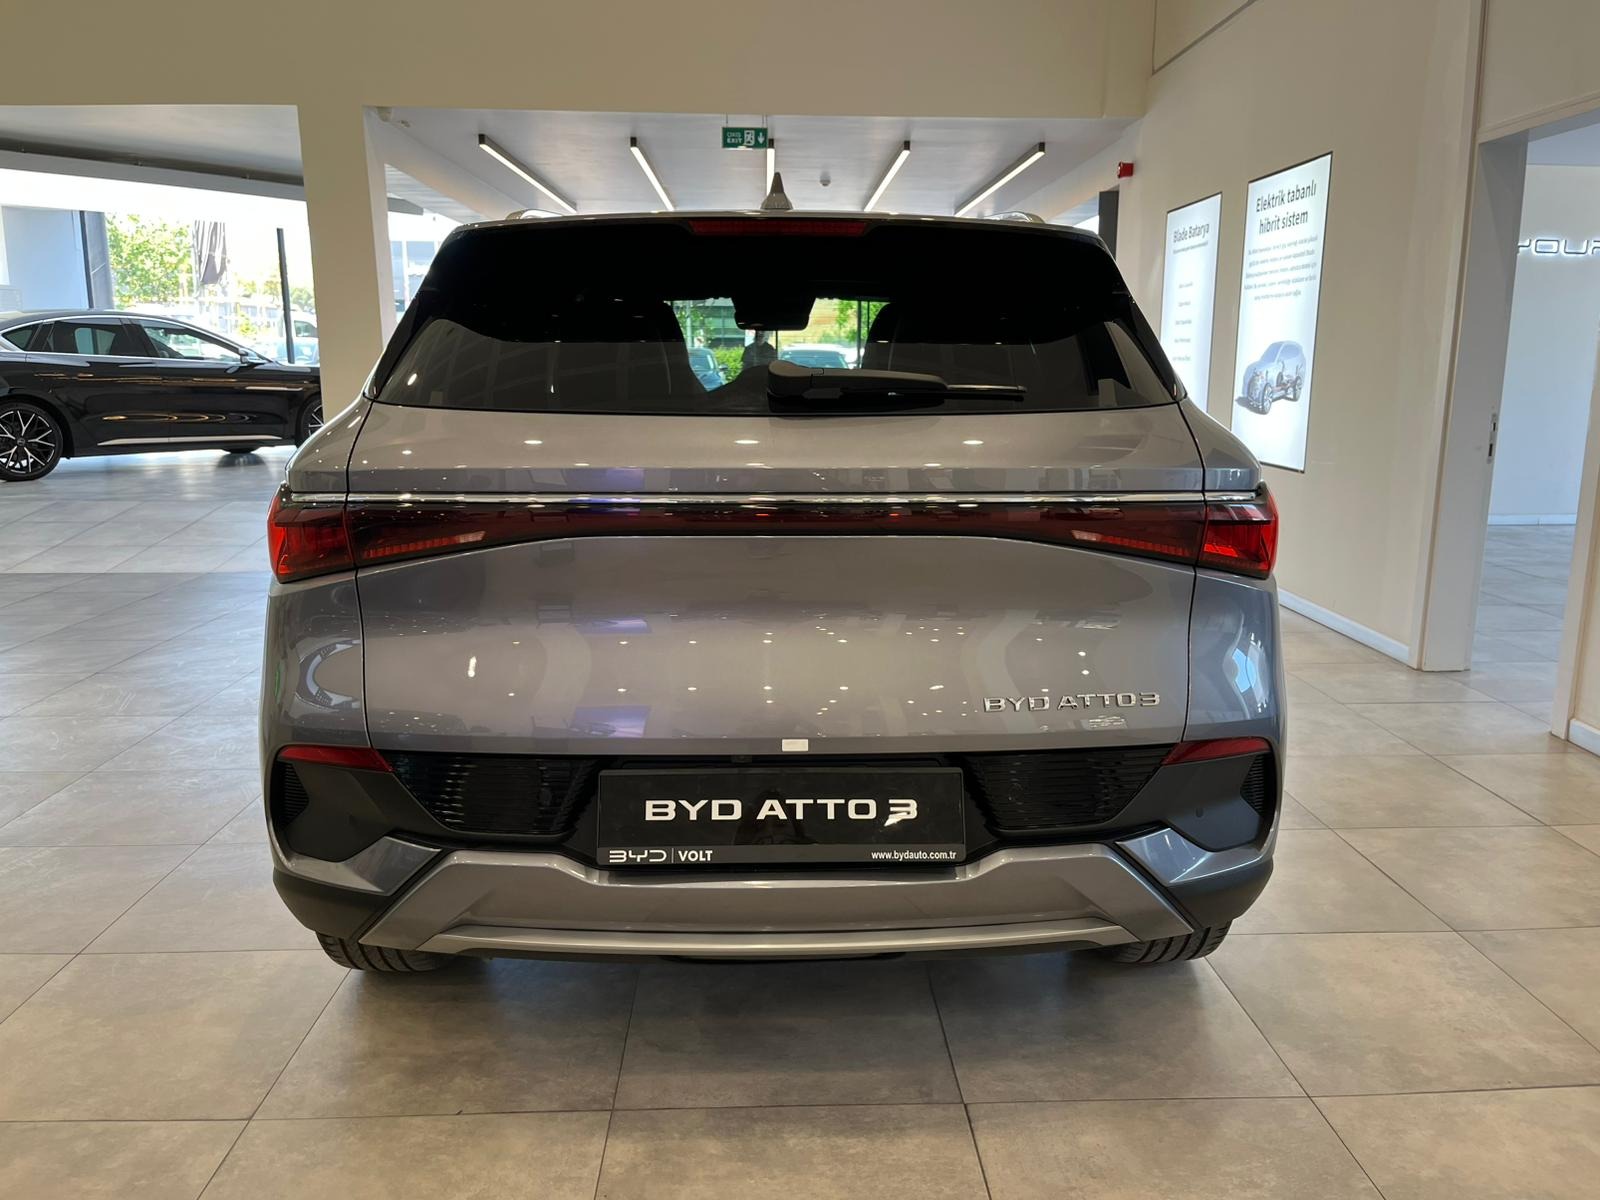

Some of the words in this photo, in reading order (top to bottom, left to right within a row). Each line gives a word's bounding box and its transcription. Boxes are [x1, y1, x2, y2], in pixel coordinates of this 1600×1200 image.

[1256, 188, 1285, 212] Elektrik
[1287, 180, 1317, 204] tabanlı
[1173, 228, 1188, 243] Blade
[1188, 222, 1209, 241] Batarya
[1259, 214, 1280, 235] hibrit
[1281, 210, 1308, 229] sistem
[983, 696, 1050, 713] BYD
[644, 798, 743, 821] BYD
[756, 798, 877, 821] ATTO
[886, 798, 918, 823] 3
[609, 849, 667, 863] BYD
[678, 850, 713, 862] VOLT
[871, 850, 957, 862] www.bydauto.com.tr
